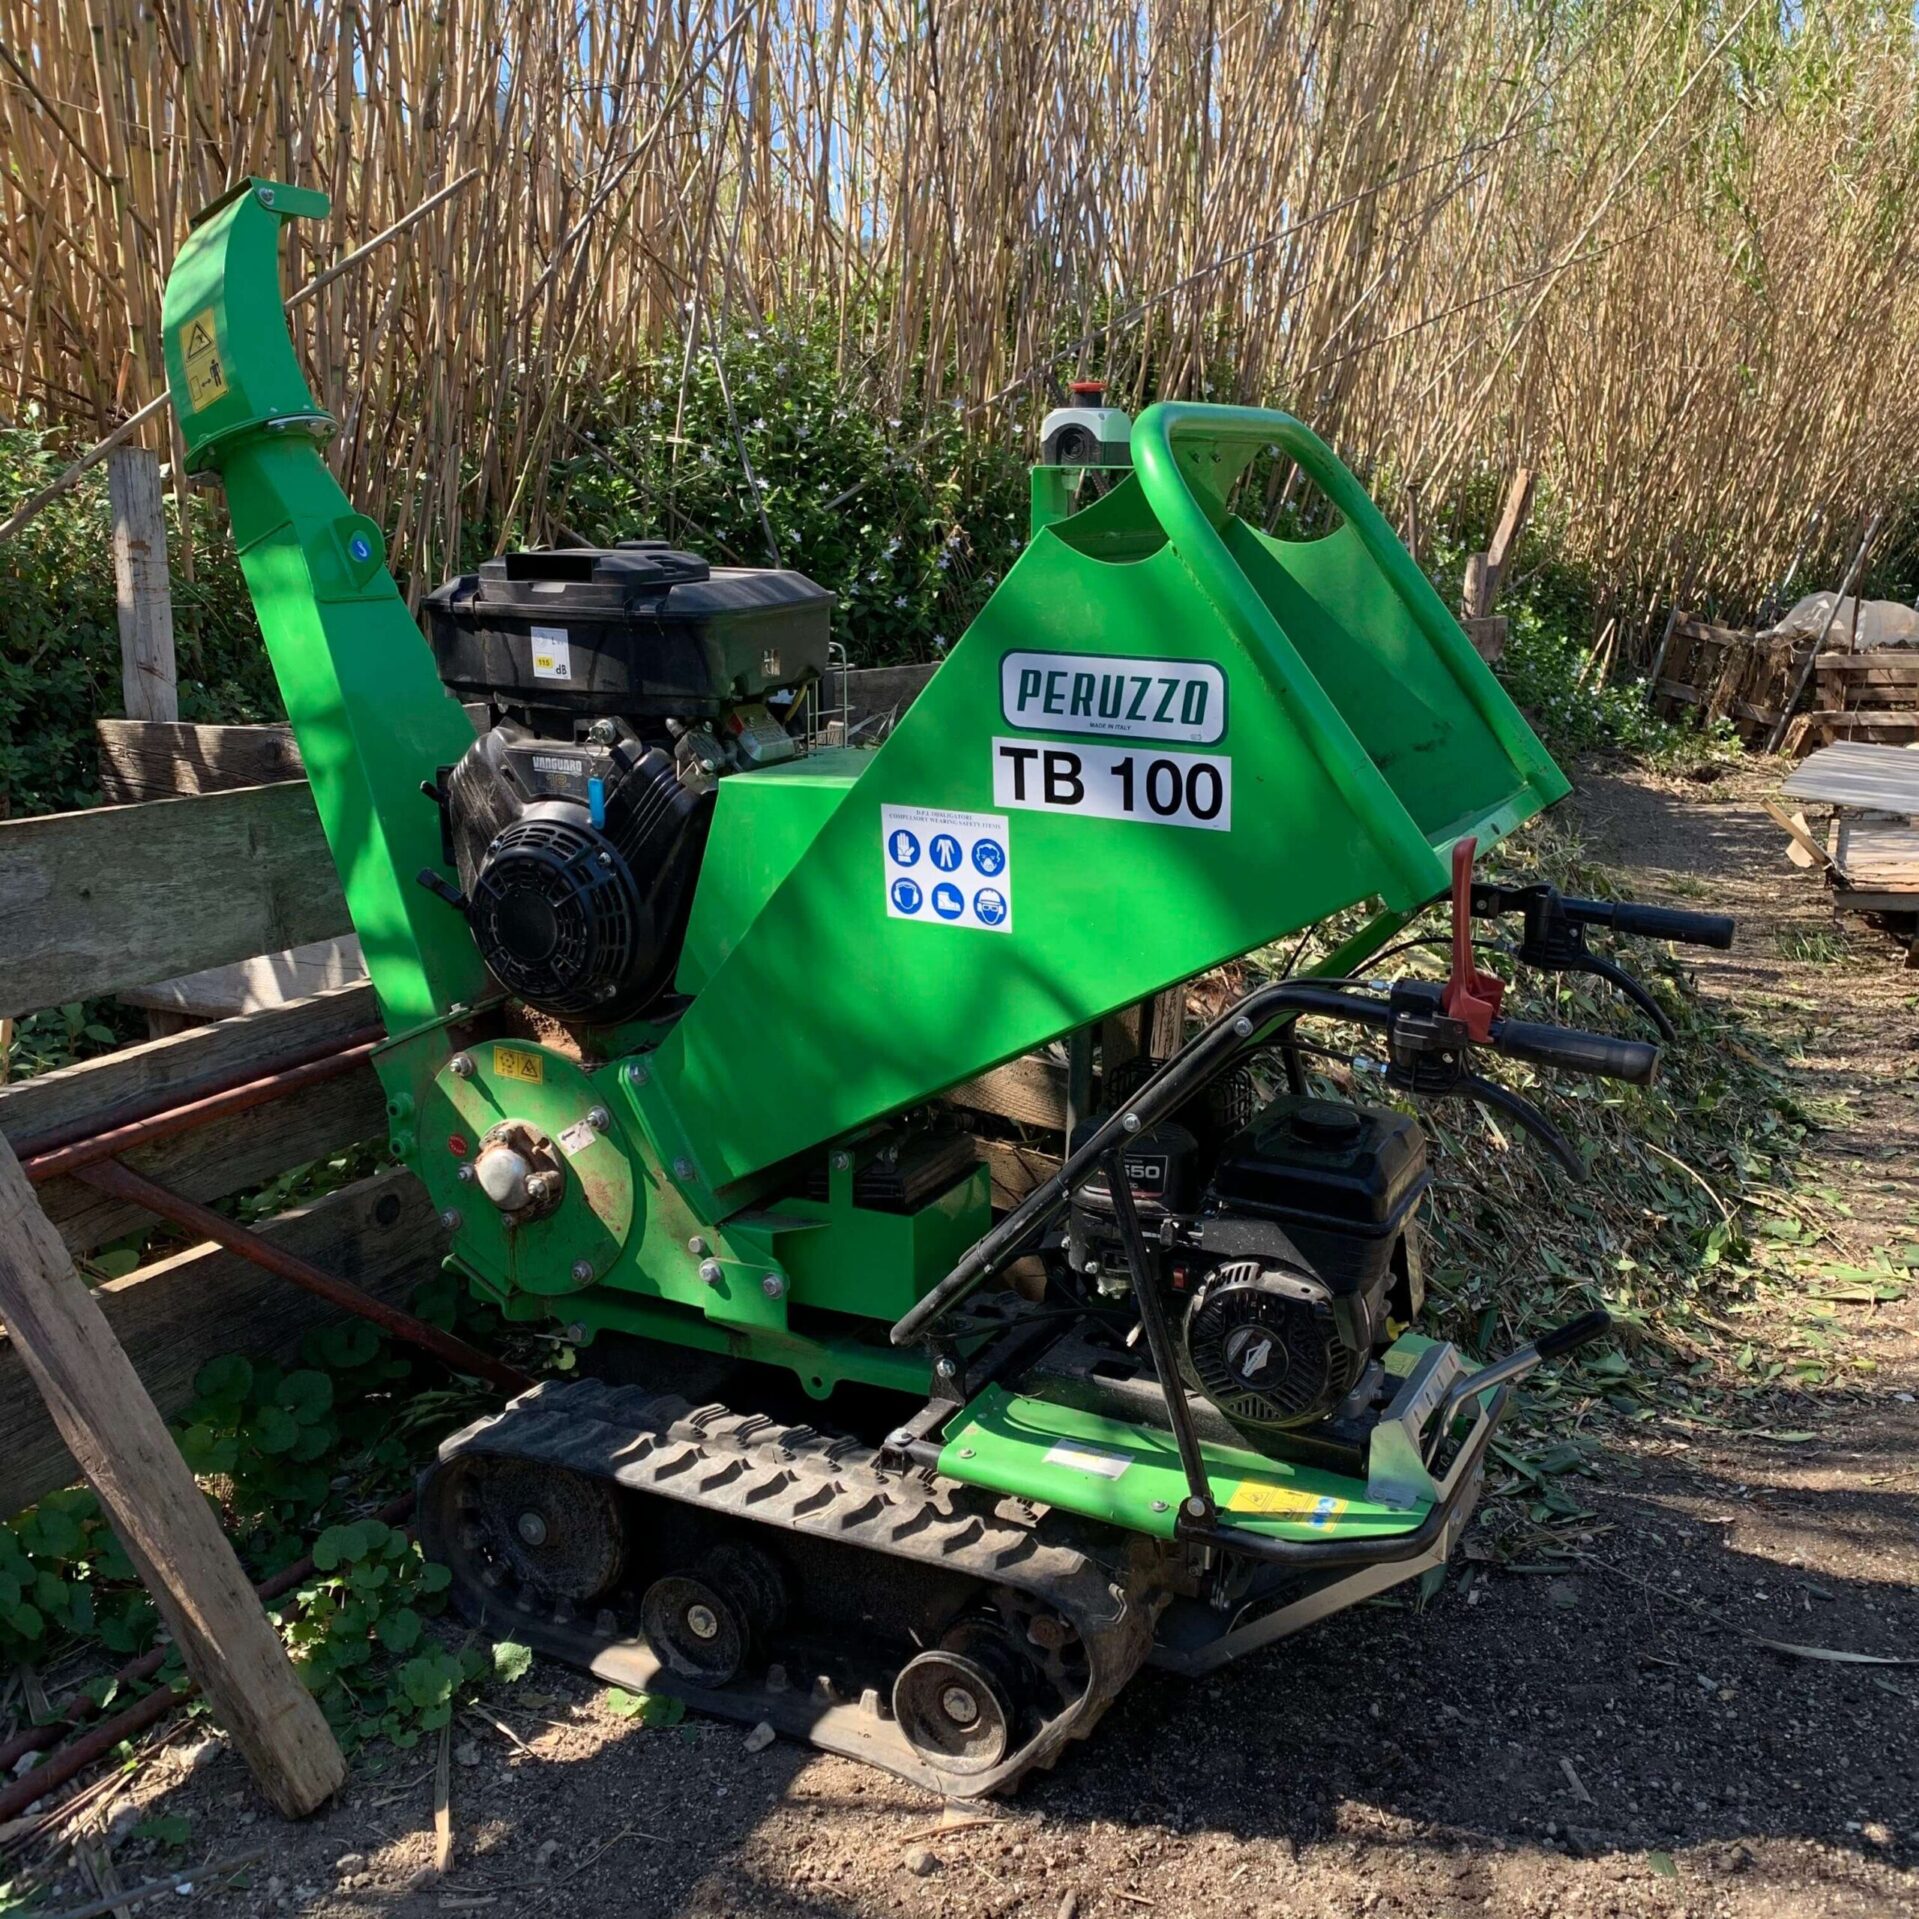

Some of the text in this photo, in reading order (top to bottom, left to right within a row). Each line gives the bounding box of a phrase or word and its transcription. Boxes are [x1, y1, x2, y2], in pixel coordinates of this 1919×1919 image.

[556, 664, 567, 675] dB
[1017, 669, 1209, 726] PERUZZO
[532, 756, 582, 773] VANGUARD
[1000, 746, 1223, 820] TB 100
